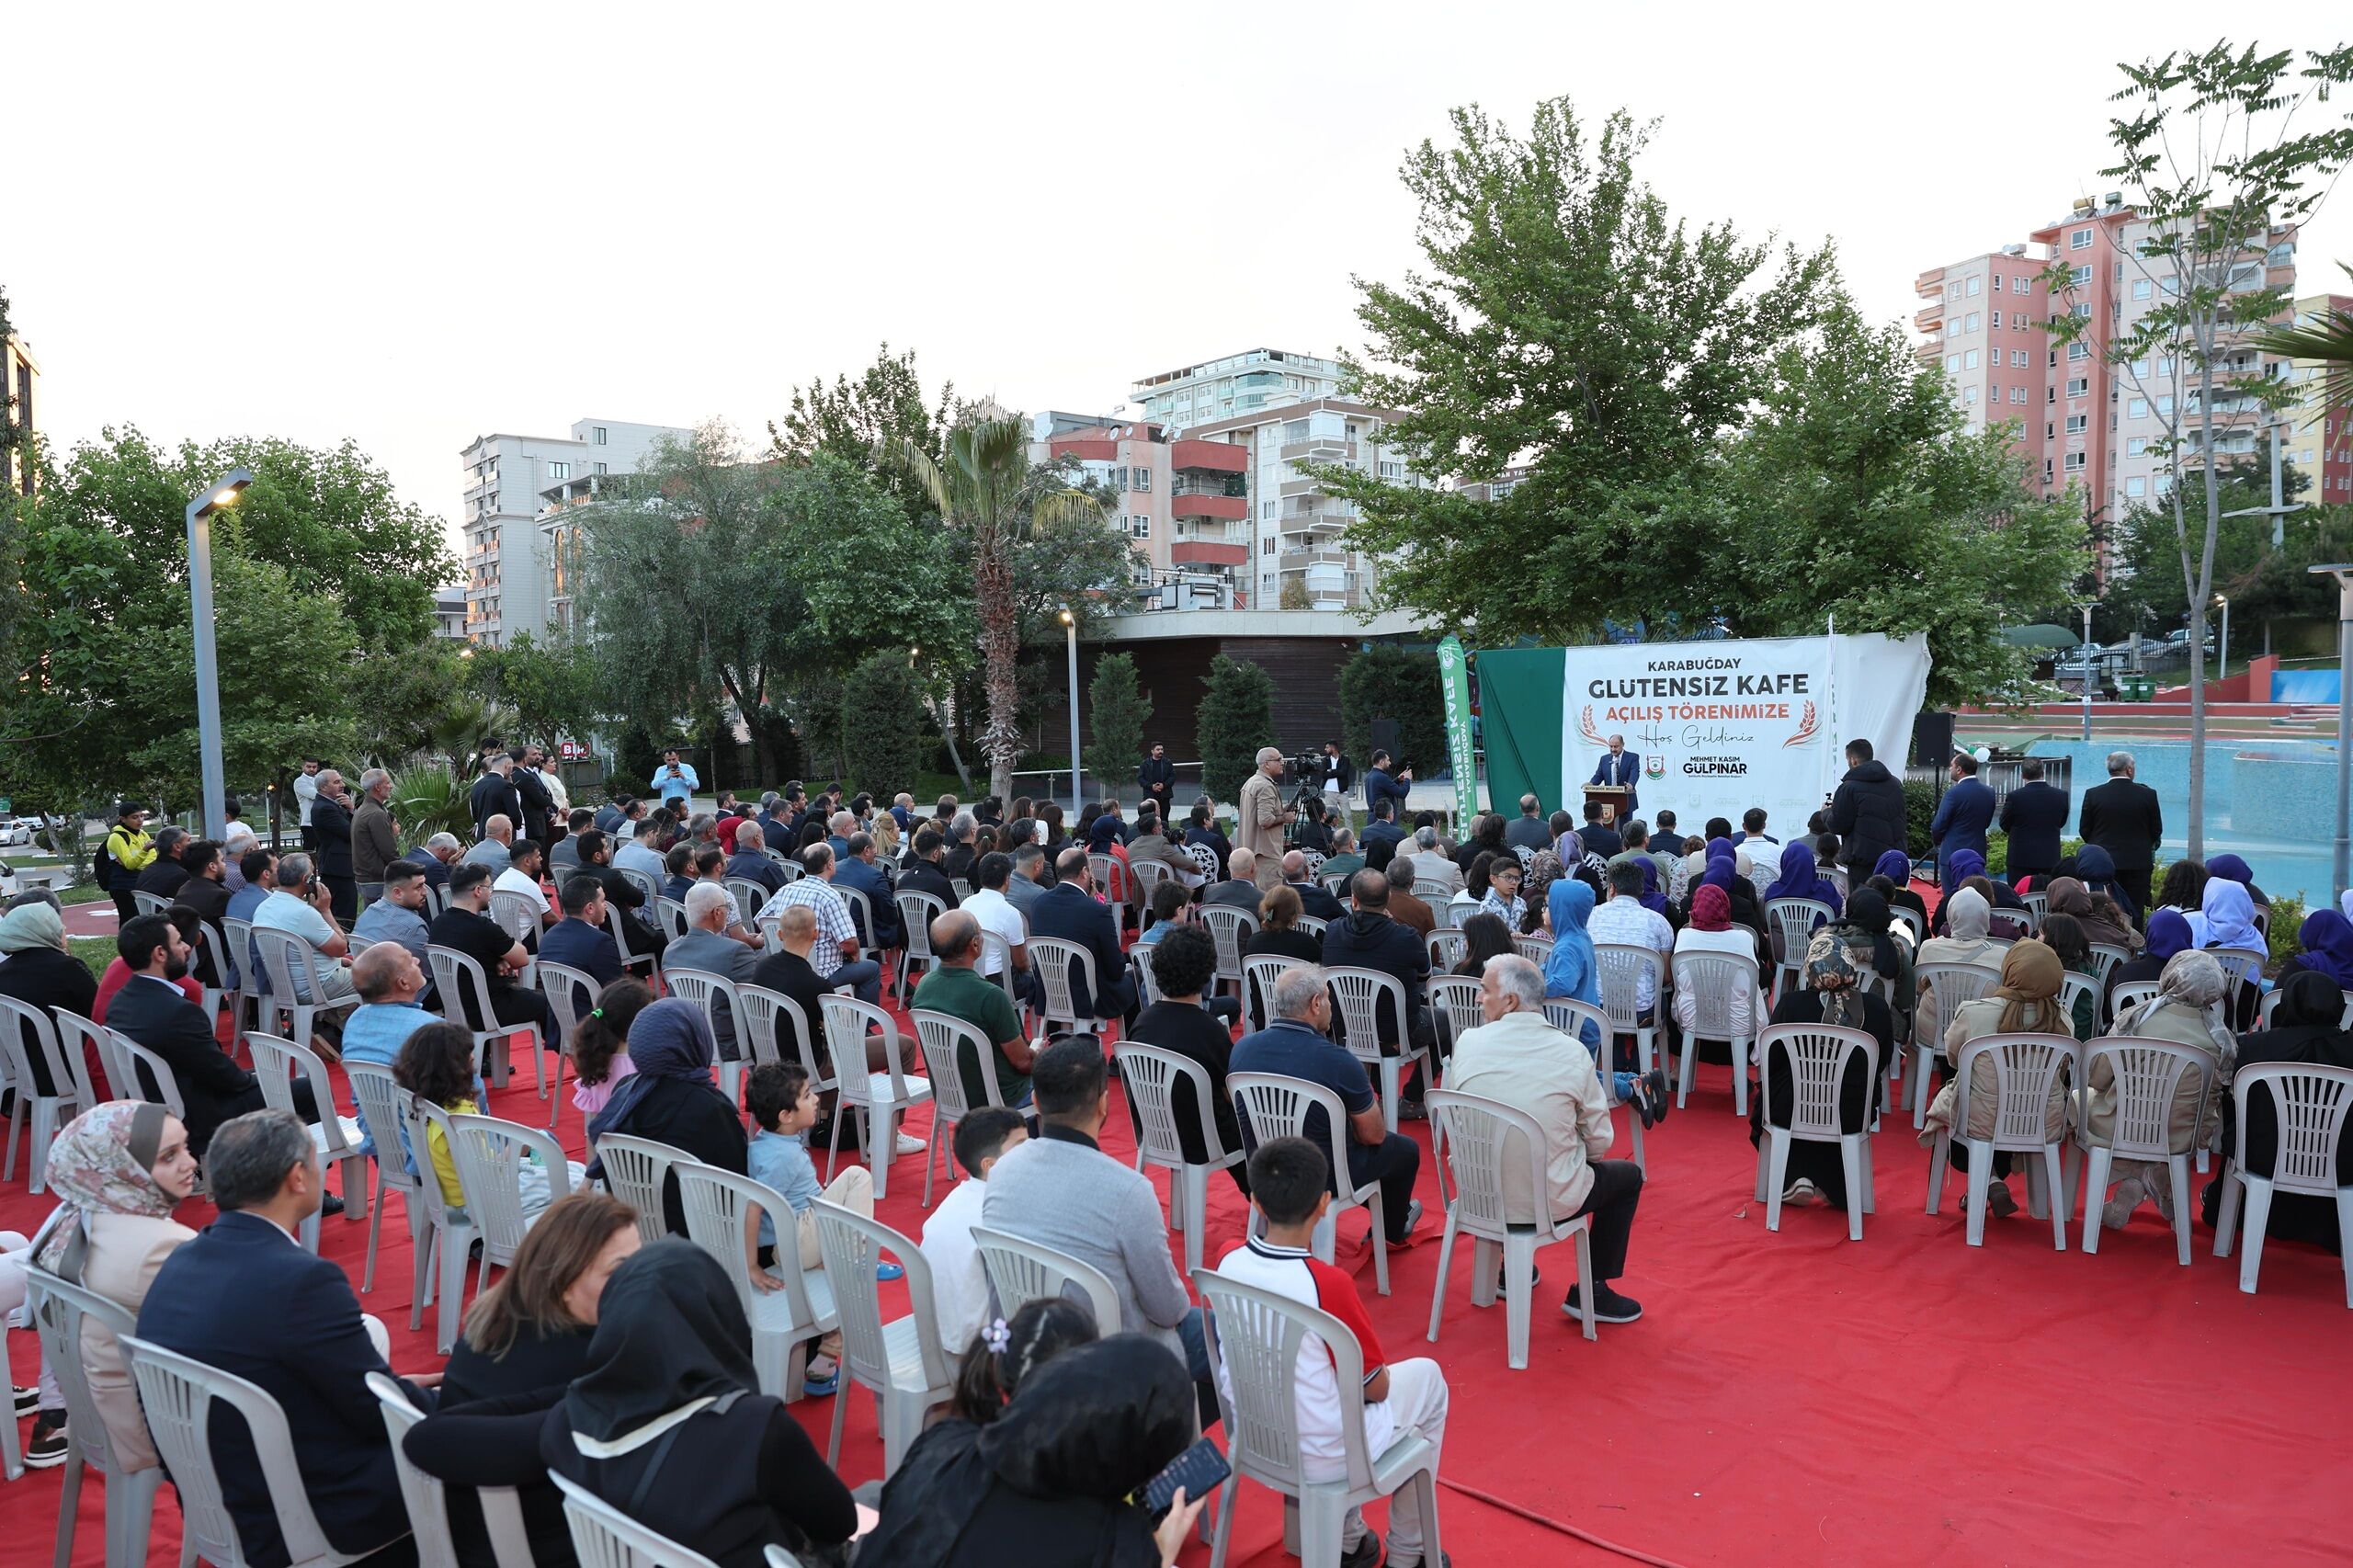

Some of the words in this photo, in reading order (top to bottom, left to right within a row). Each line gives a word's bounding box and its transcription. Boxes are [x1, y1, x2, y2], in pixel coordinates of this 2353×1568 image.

[1648, 656, 1742, 672] KARABUĞDAY
[1588, 676, 1729, 699] GLÜTENSİZ
[1737, 674, 1809, 696] KAFE
[1605, 705, 1663, 724] AÇILIŞ
[1668, 701, 1790, 721] TÖRENİMİZE
[1637, 724, 1673, 748] Hoş
[1681, 724, 1755, 750] Geldiniz
[1682, 763, 1747, 774] GÜLPINAR
